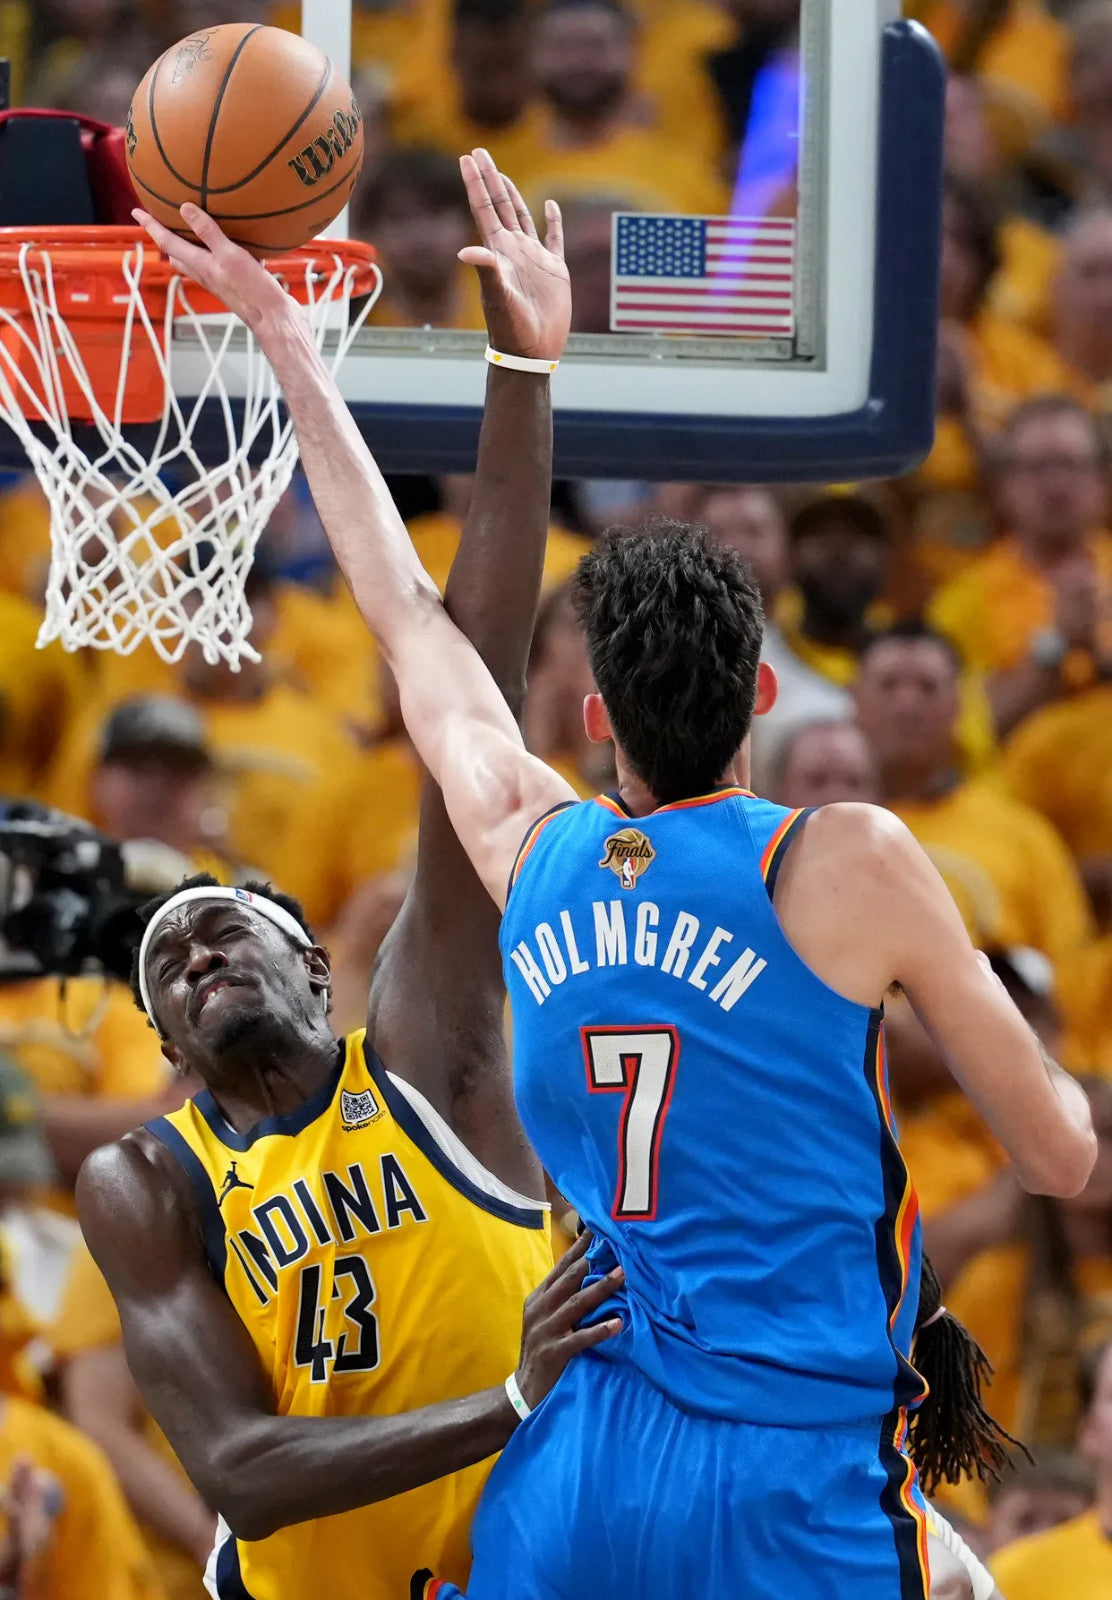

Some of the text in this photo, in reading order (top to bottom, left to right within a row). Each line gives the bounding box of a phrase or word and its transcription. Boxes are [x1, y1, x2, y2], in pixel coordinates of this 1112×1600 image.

[600, 838, 653, 865] Finals
[510, 899, 768, 1013] HOLMGREN
[579, 1024, 681, 1221] 7
[294, 1253, 382, 1385] 43
